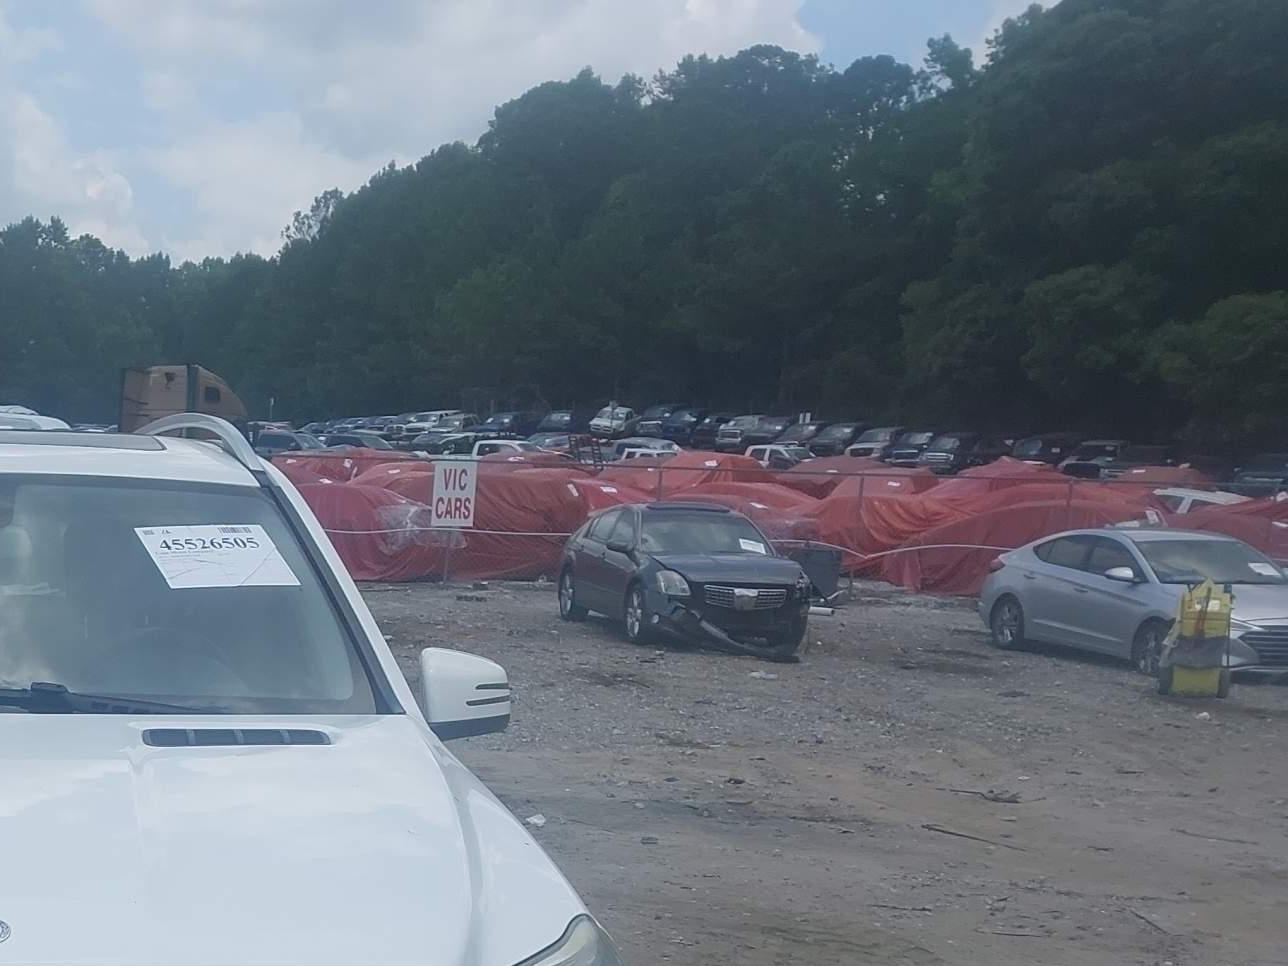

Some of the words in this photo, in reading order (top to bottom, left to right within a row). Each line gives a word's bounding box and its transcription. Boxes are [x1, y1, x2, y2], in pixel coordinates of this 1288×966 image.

[443, 468, 468, 491] VIC
[435, 496, 471, 519] CARS
[160, 537, 260, 551] 45526505
